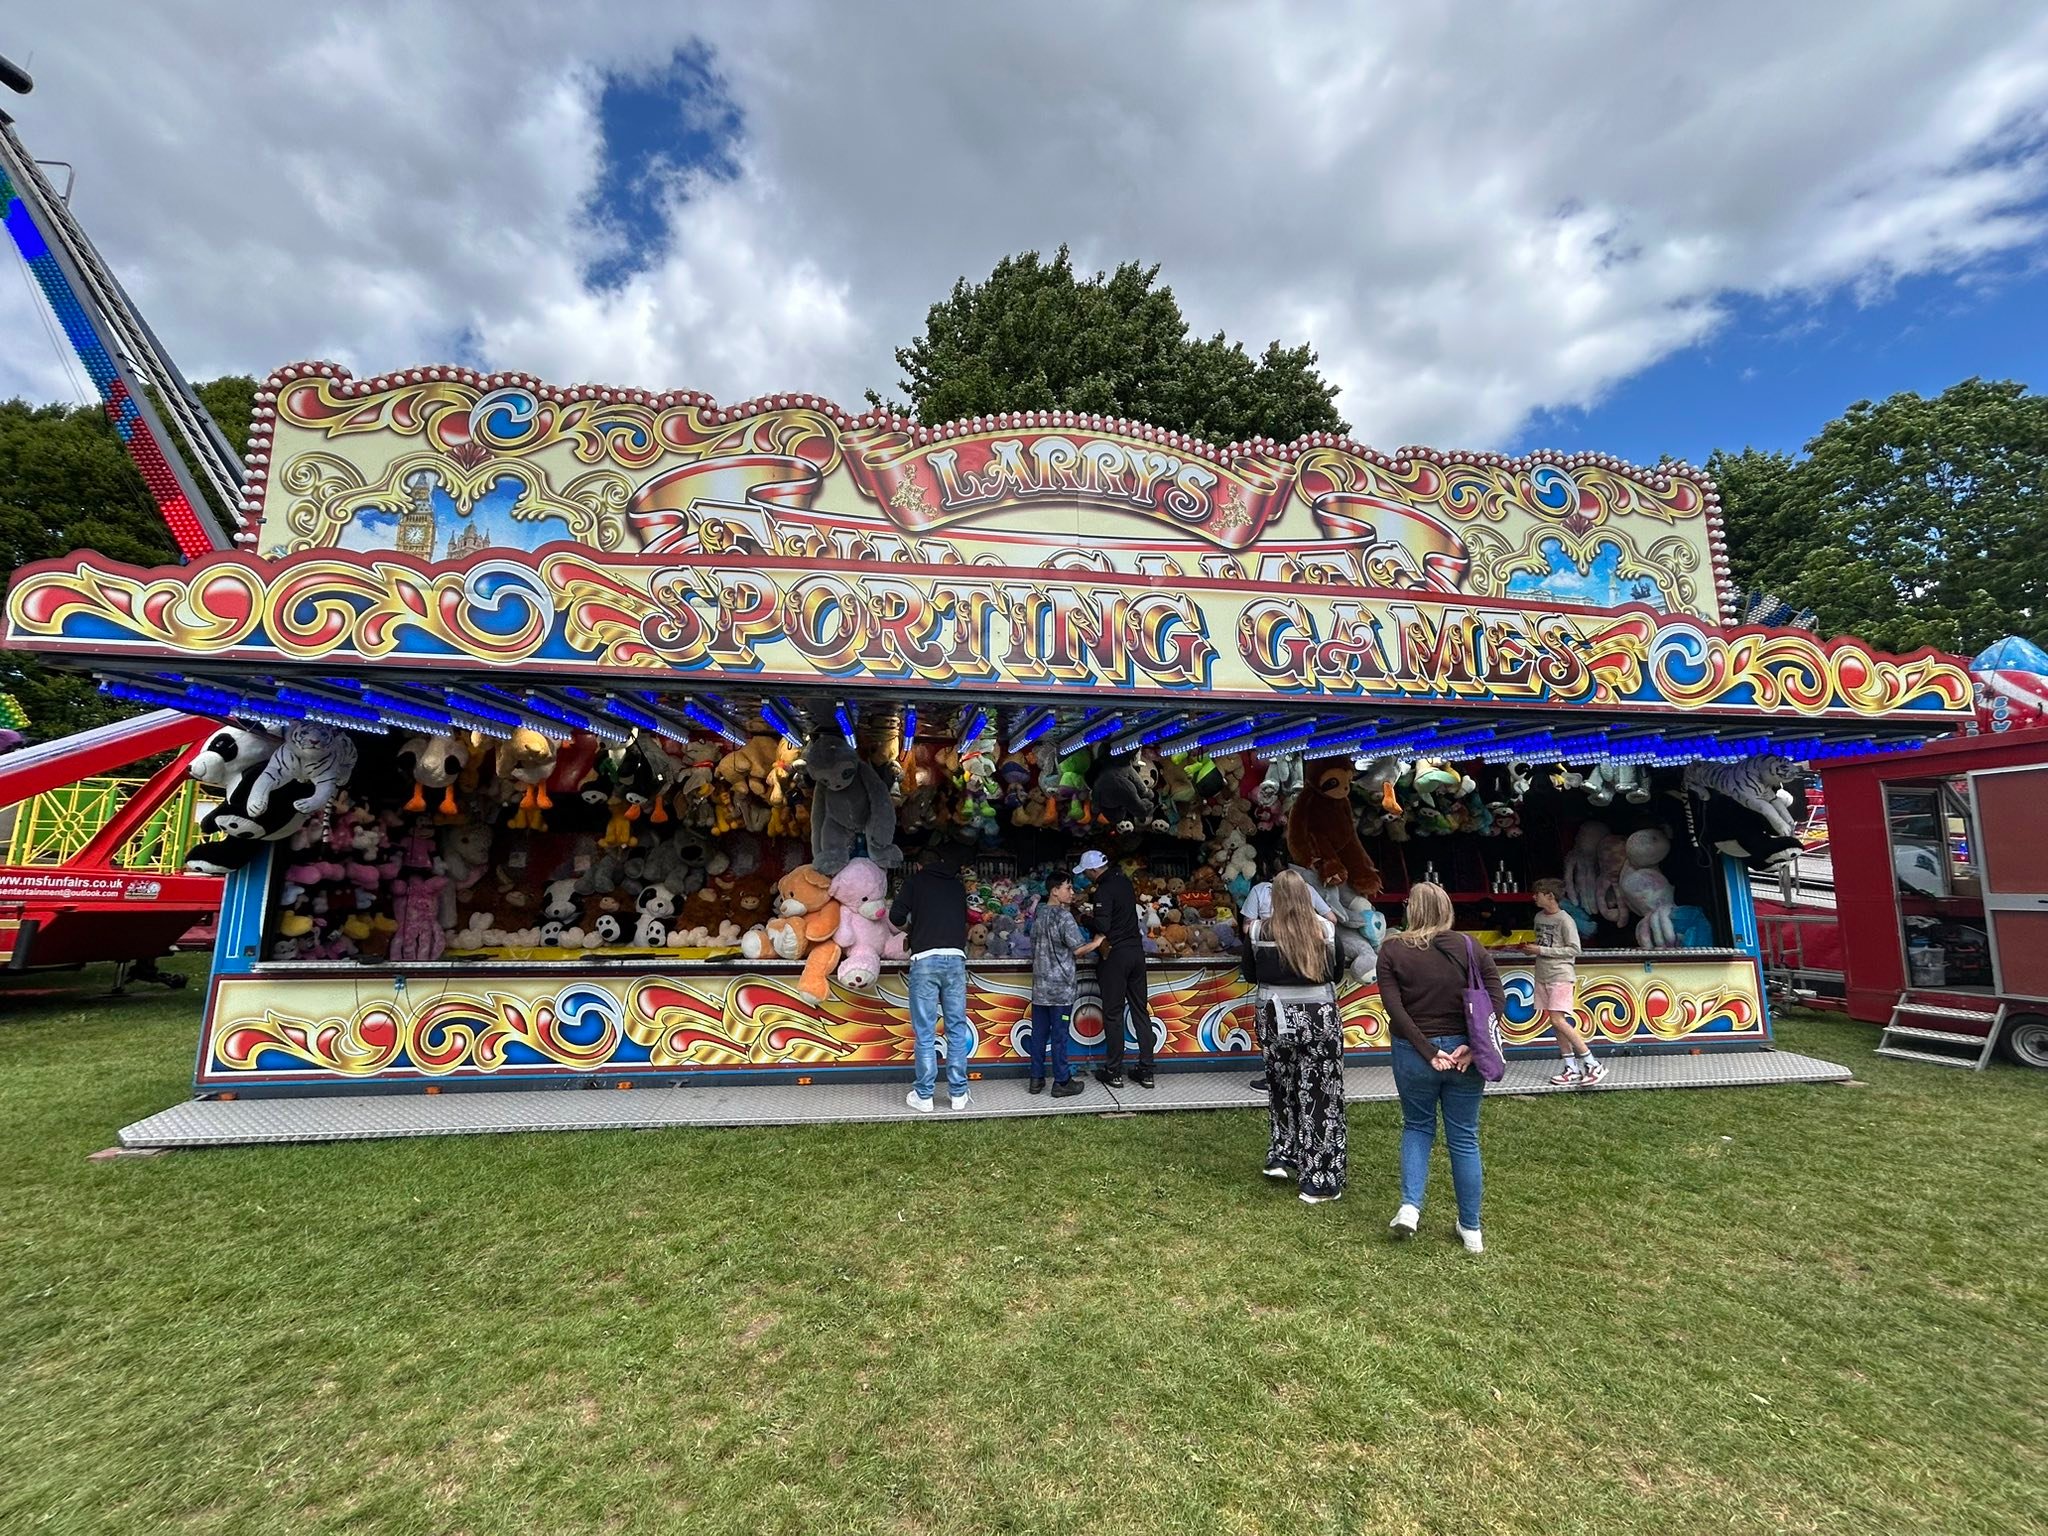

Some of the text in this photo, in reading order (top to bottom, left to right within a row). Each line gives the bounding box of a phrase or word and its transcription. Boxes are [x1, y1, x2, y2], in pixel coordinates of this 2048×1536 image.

[927, 436, 1218, 522] LARRY'S
[640, 564, 1597, 704] SPORTING GAMES
